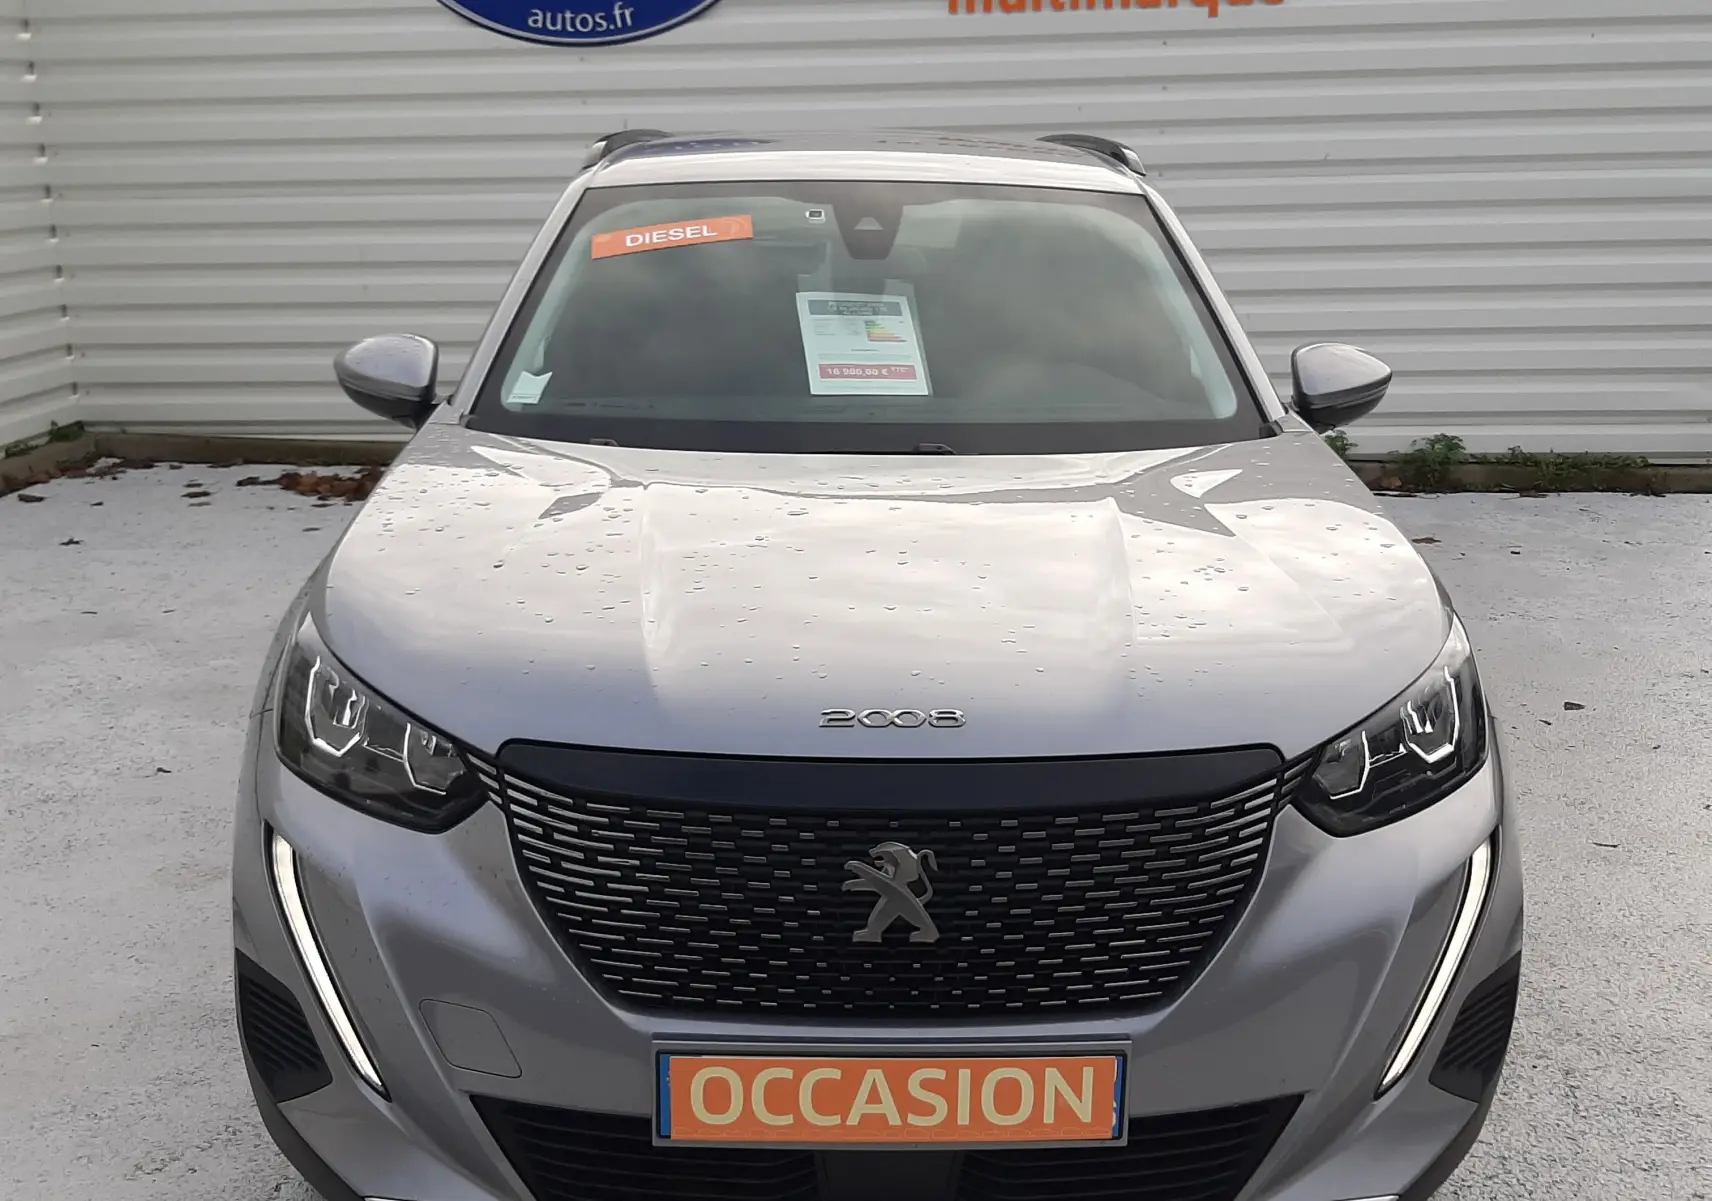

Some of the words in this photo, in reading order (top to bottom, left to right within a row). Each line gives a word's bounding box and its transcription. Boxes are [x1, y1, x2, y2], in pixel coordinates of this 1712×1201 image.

[527, 1, 635, 32] autos.fr
[625, 225, 718, 248] DIESEL
[818, 708, 968, 728] 2008
[690, 1066, 1095, 1126] OCCASION
